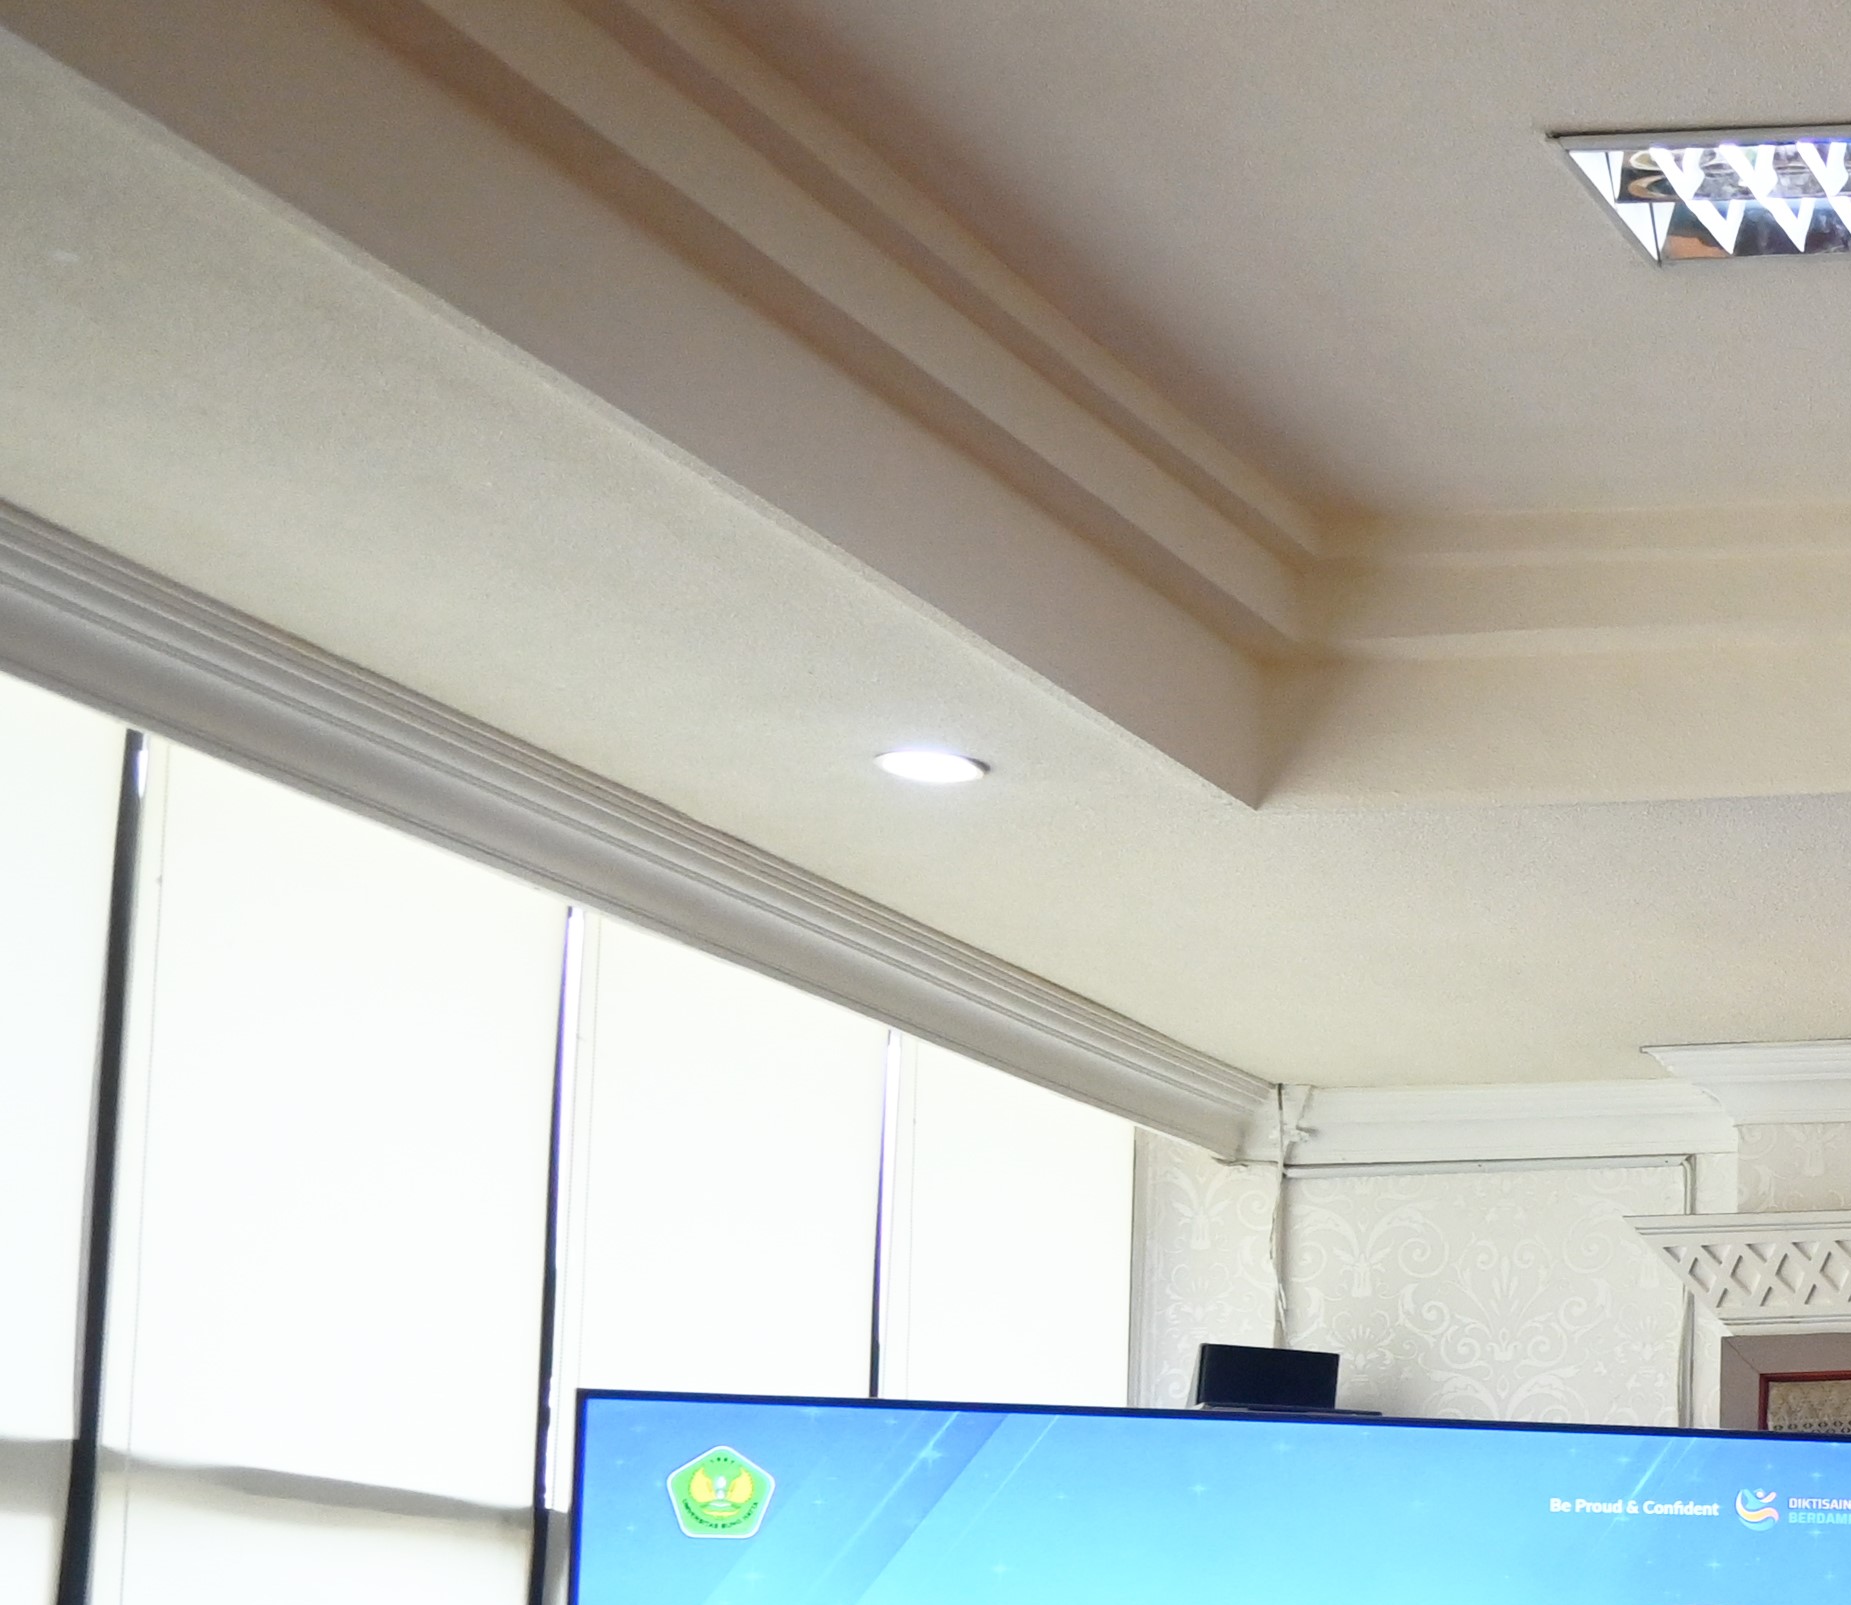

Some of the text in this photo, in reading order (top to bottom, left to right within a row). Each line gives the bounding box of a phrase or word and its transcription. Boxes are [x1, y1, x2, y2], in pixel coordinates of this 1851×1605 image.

[1550, 1498, 1719, 1517] Be Proud & Confident
